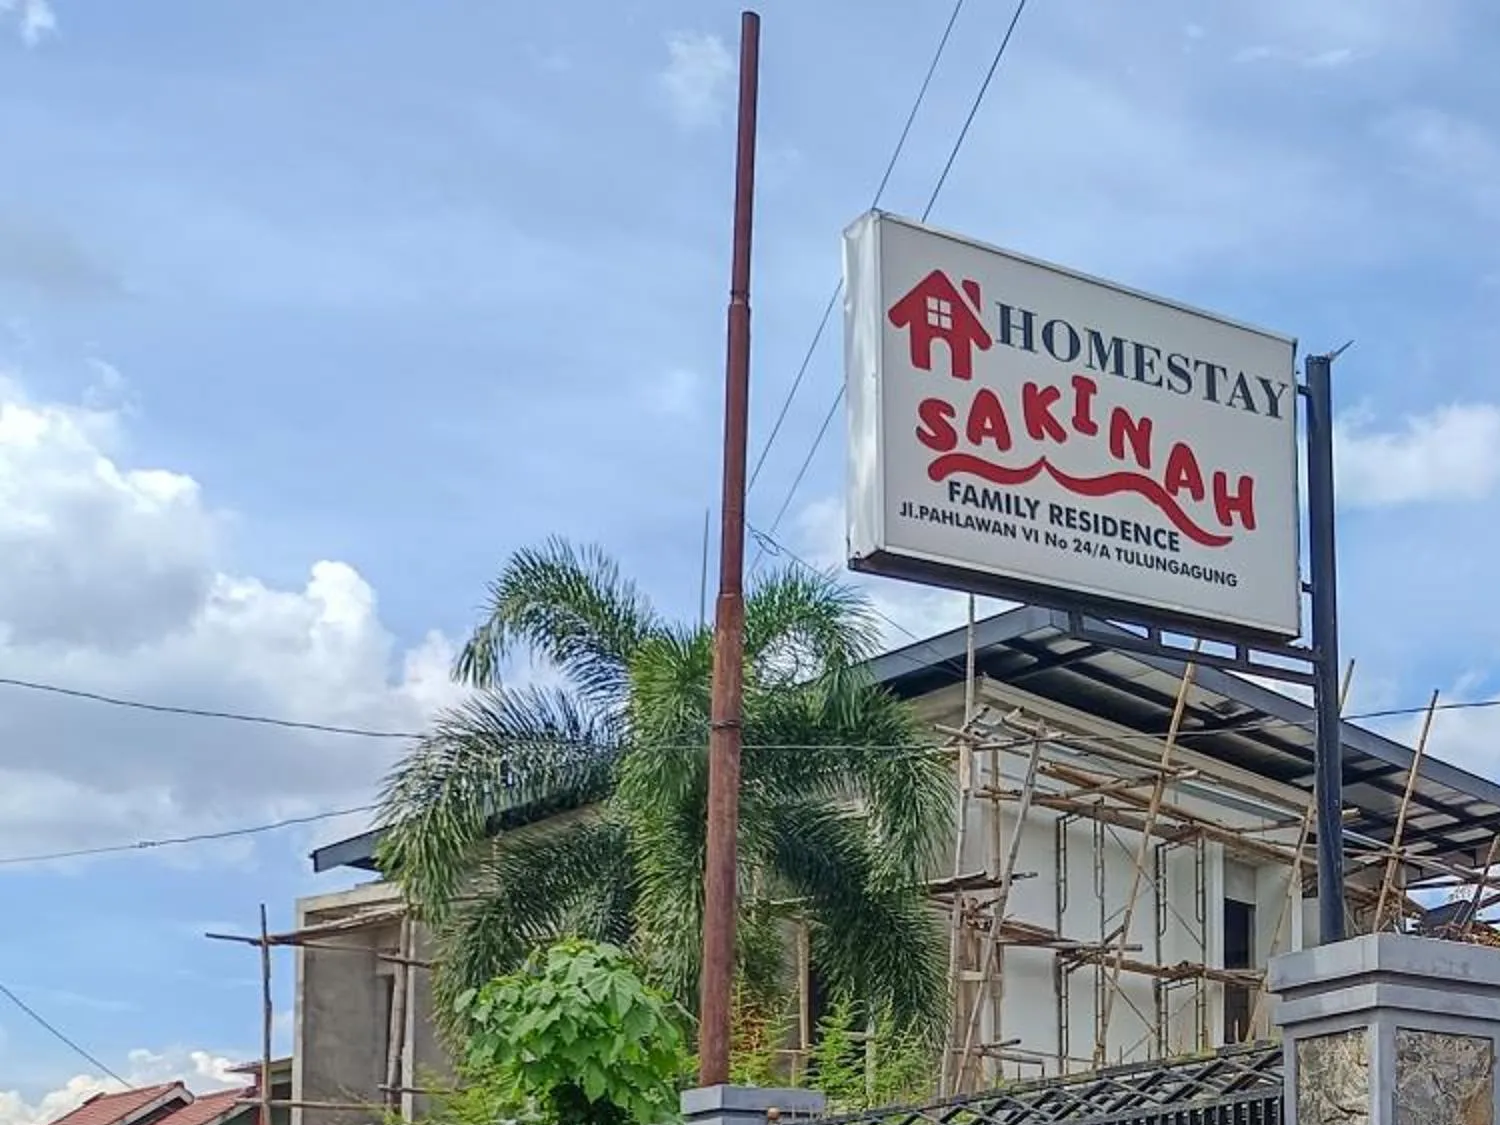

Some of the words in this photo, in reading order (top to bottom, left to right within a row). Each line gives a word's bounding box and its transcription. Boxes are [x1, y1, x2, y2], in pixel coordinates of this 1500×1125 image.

[995, 302, 1289, 419] HOMESTAY
[915, 375, 1256, 531] SAKINAH
[948, 480, 1041, 522] FAMILY
[1048, 502, 1181, 553] RESIDENCE
[1021, 525, 1040, 544] VI
[1044, 531, 1068, 551] No
[1072, 537, 1112, 561] 24/A
[1115, 546, 1238, 588] TULUNGAGUNG
